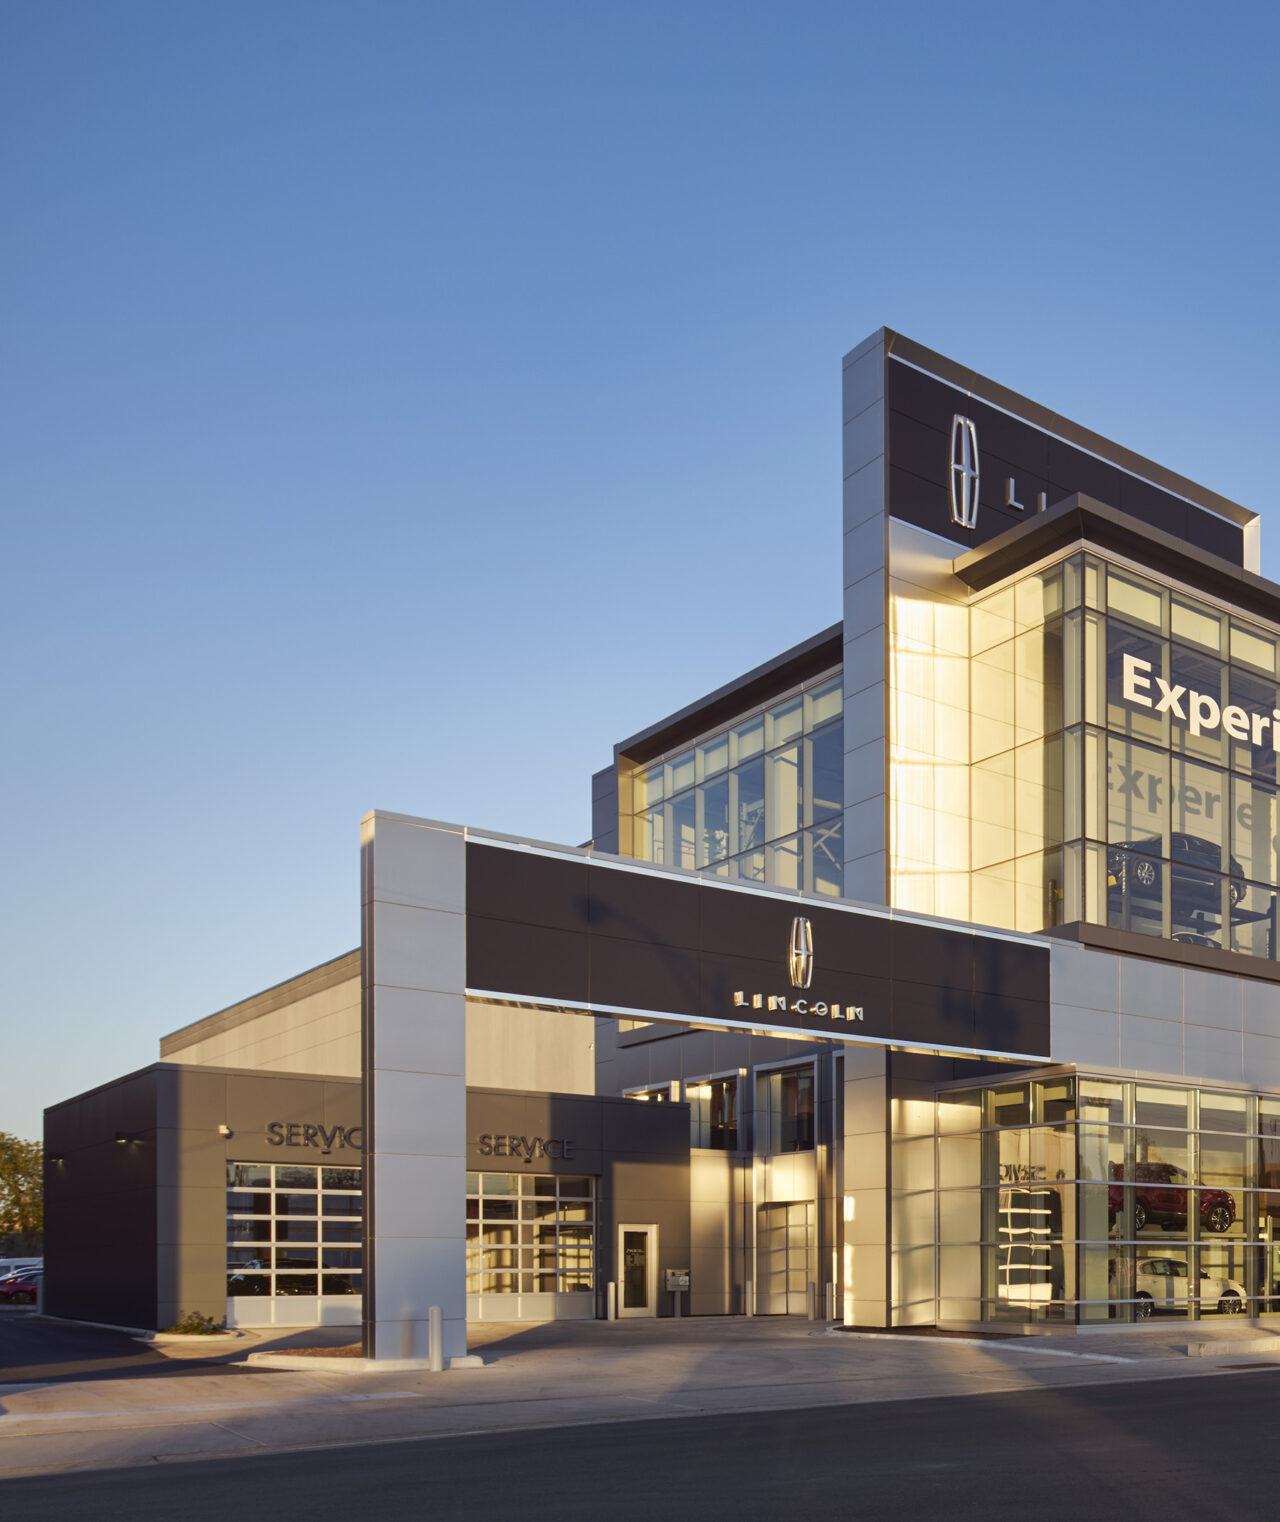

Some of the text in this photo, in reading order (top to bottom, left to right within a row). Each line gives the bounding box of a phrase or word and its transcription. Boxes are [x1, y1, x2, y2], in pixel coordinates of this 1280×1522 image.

[734, 991, 863, 1021] LINCOLN
[267, 1122, 362, 1149] SERVIC
[478, 1133, 576, 1159] SERVICE
